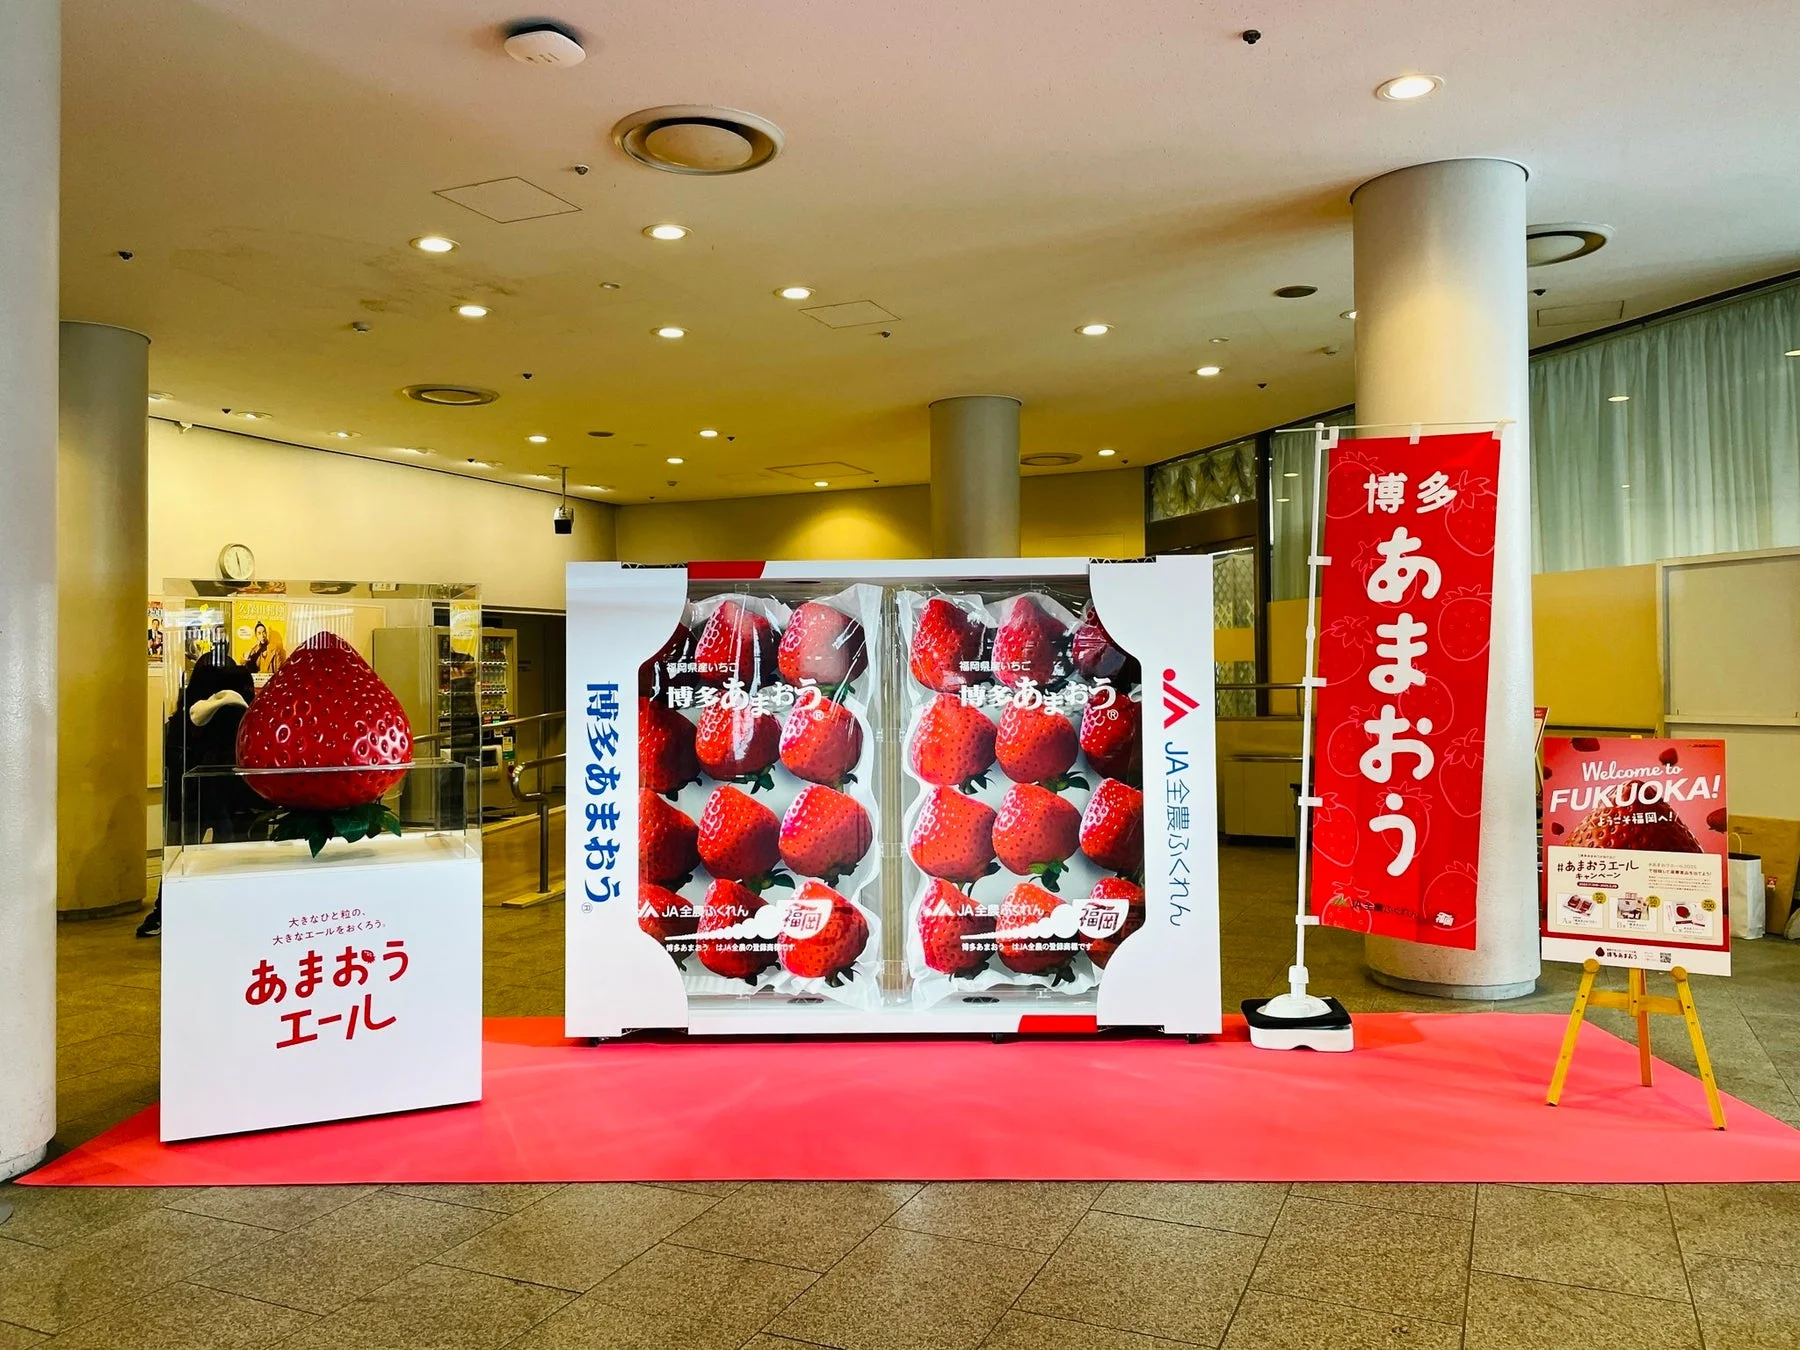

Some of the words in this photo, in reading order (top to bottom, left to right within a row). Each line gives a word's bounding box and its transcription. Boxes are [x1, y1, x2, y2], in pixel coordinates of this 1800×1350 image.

[1363, 470, 1457, 514] 博多
[666, 662, 738, 673] 福岡県産いちご
[959, 661, 1031, 672] 福岡県産いちご
[666, 677, 822, 718] 博多あまおう
[959, 676, 1117, 715] 博多あまおう
[1359, 526, 1442, 877] あまおう
[1582, 761, 1664, 782] Welcome
[1664, 763, 1684, 775] to
[584, 680, 621, 903] 博多あまおう
[1550, 775, 1721, 813] FUKUOKA!
[1164, 741, 1192, 927] JA全農ふくれん
[1557, 860, 1640, 872] #あまおうエール
[1575, 872, 1621, 880] キャンペーン
[288, 908, 366, 928] 大きなひと粒の、
[784, 906, 821, 931] 福岡
[956, 904, 1045, 917] JA全農ふくれん
[1079, 905, 1119, 931] 福岡
[272, 919, 386, 946] 大きなエールをおくろう。
[245, 940, 409, 1006] あまおう
[276, 993, 397, 1049] エール
